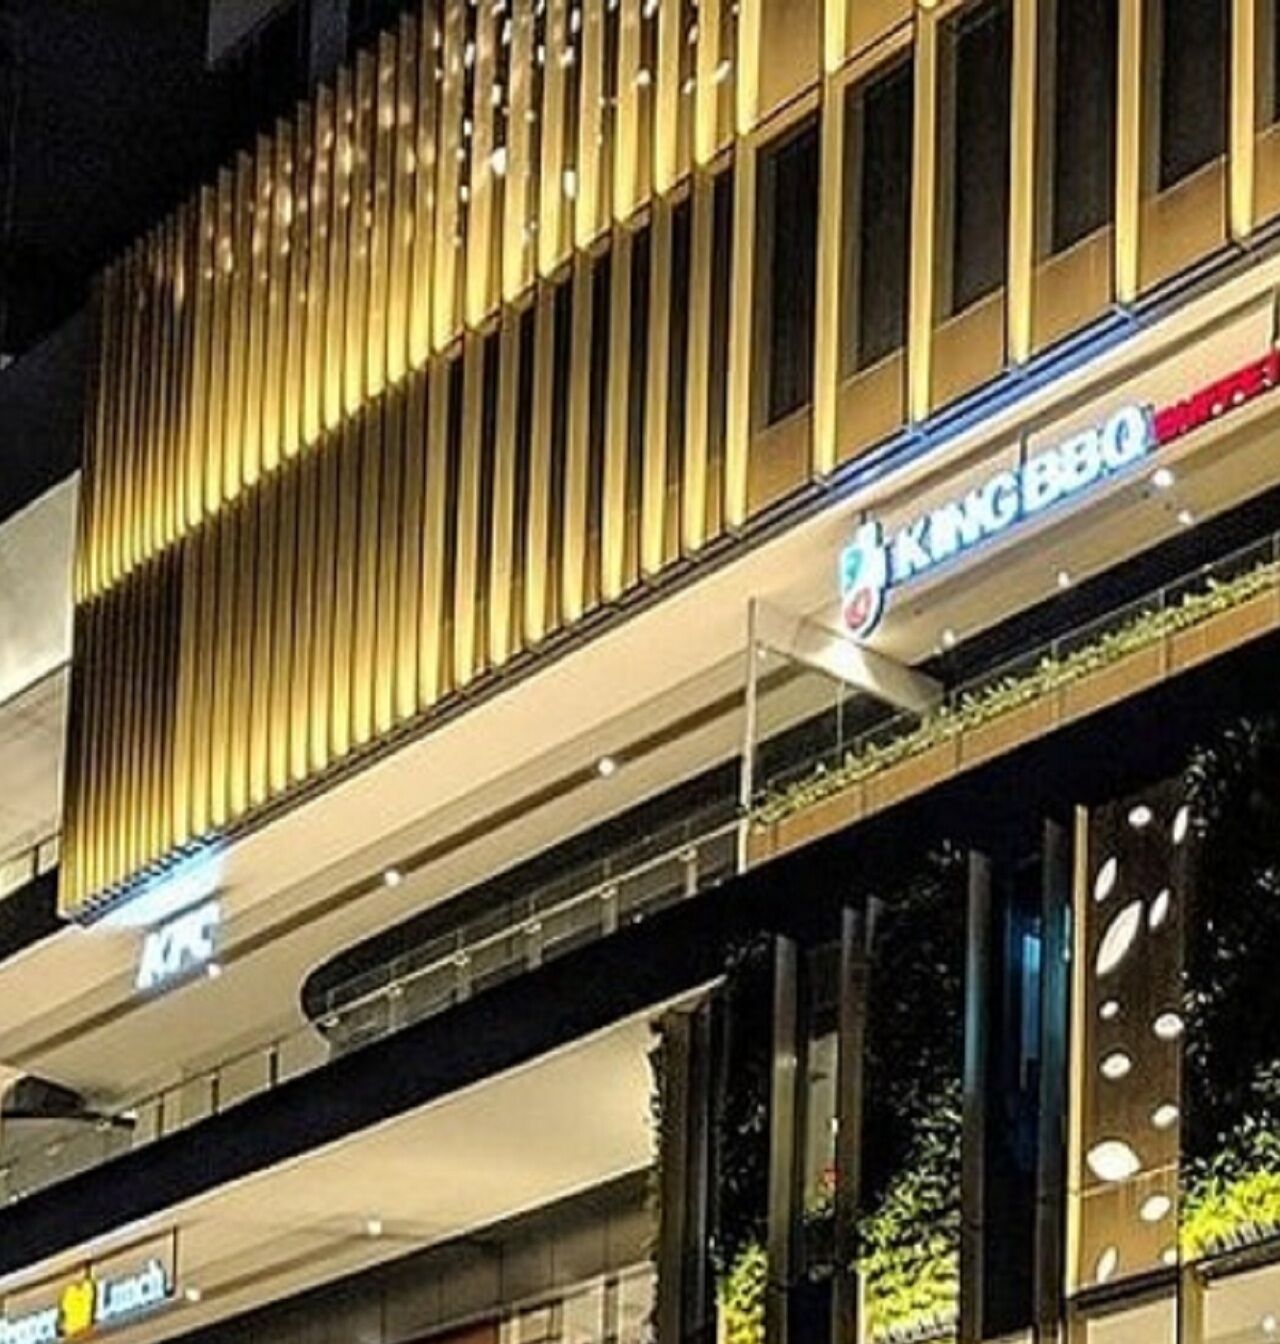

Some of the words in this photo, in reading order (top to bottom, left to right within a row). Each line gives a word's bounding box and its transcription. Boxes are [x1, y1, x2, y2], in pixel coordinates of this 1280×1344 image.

[891, 471, 1020, 581] KING
[1022, 402, 1150, 512] BBQ
[135, 900, 220, 990] KFC
